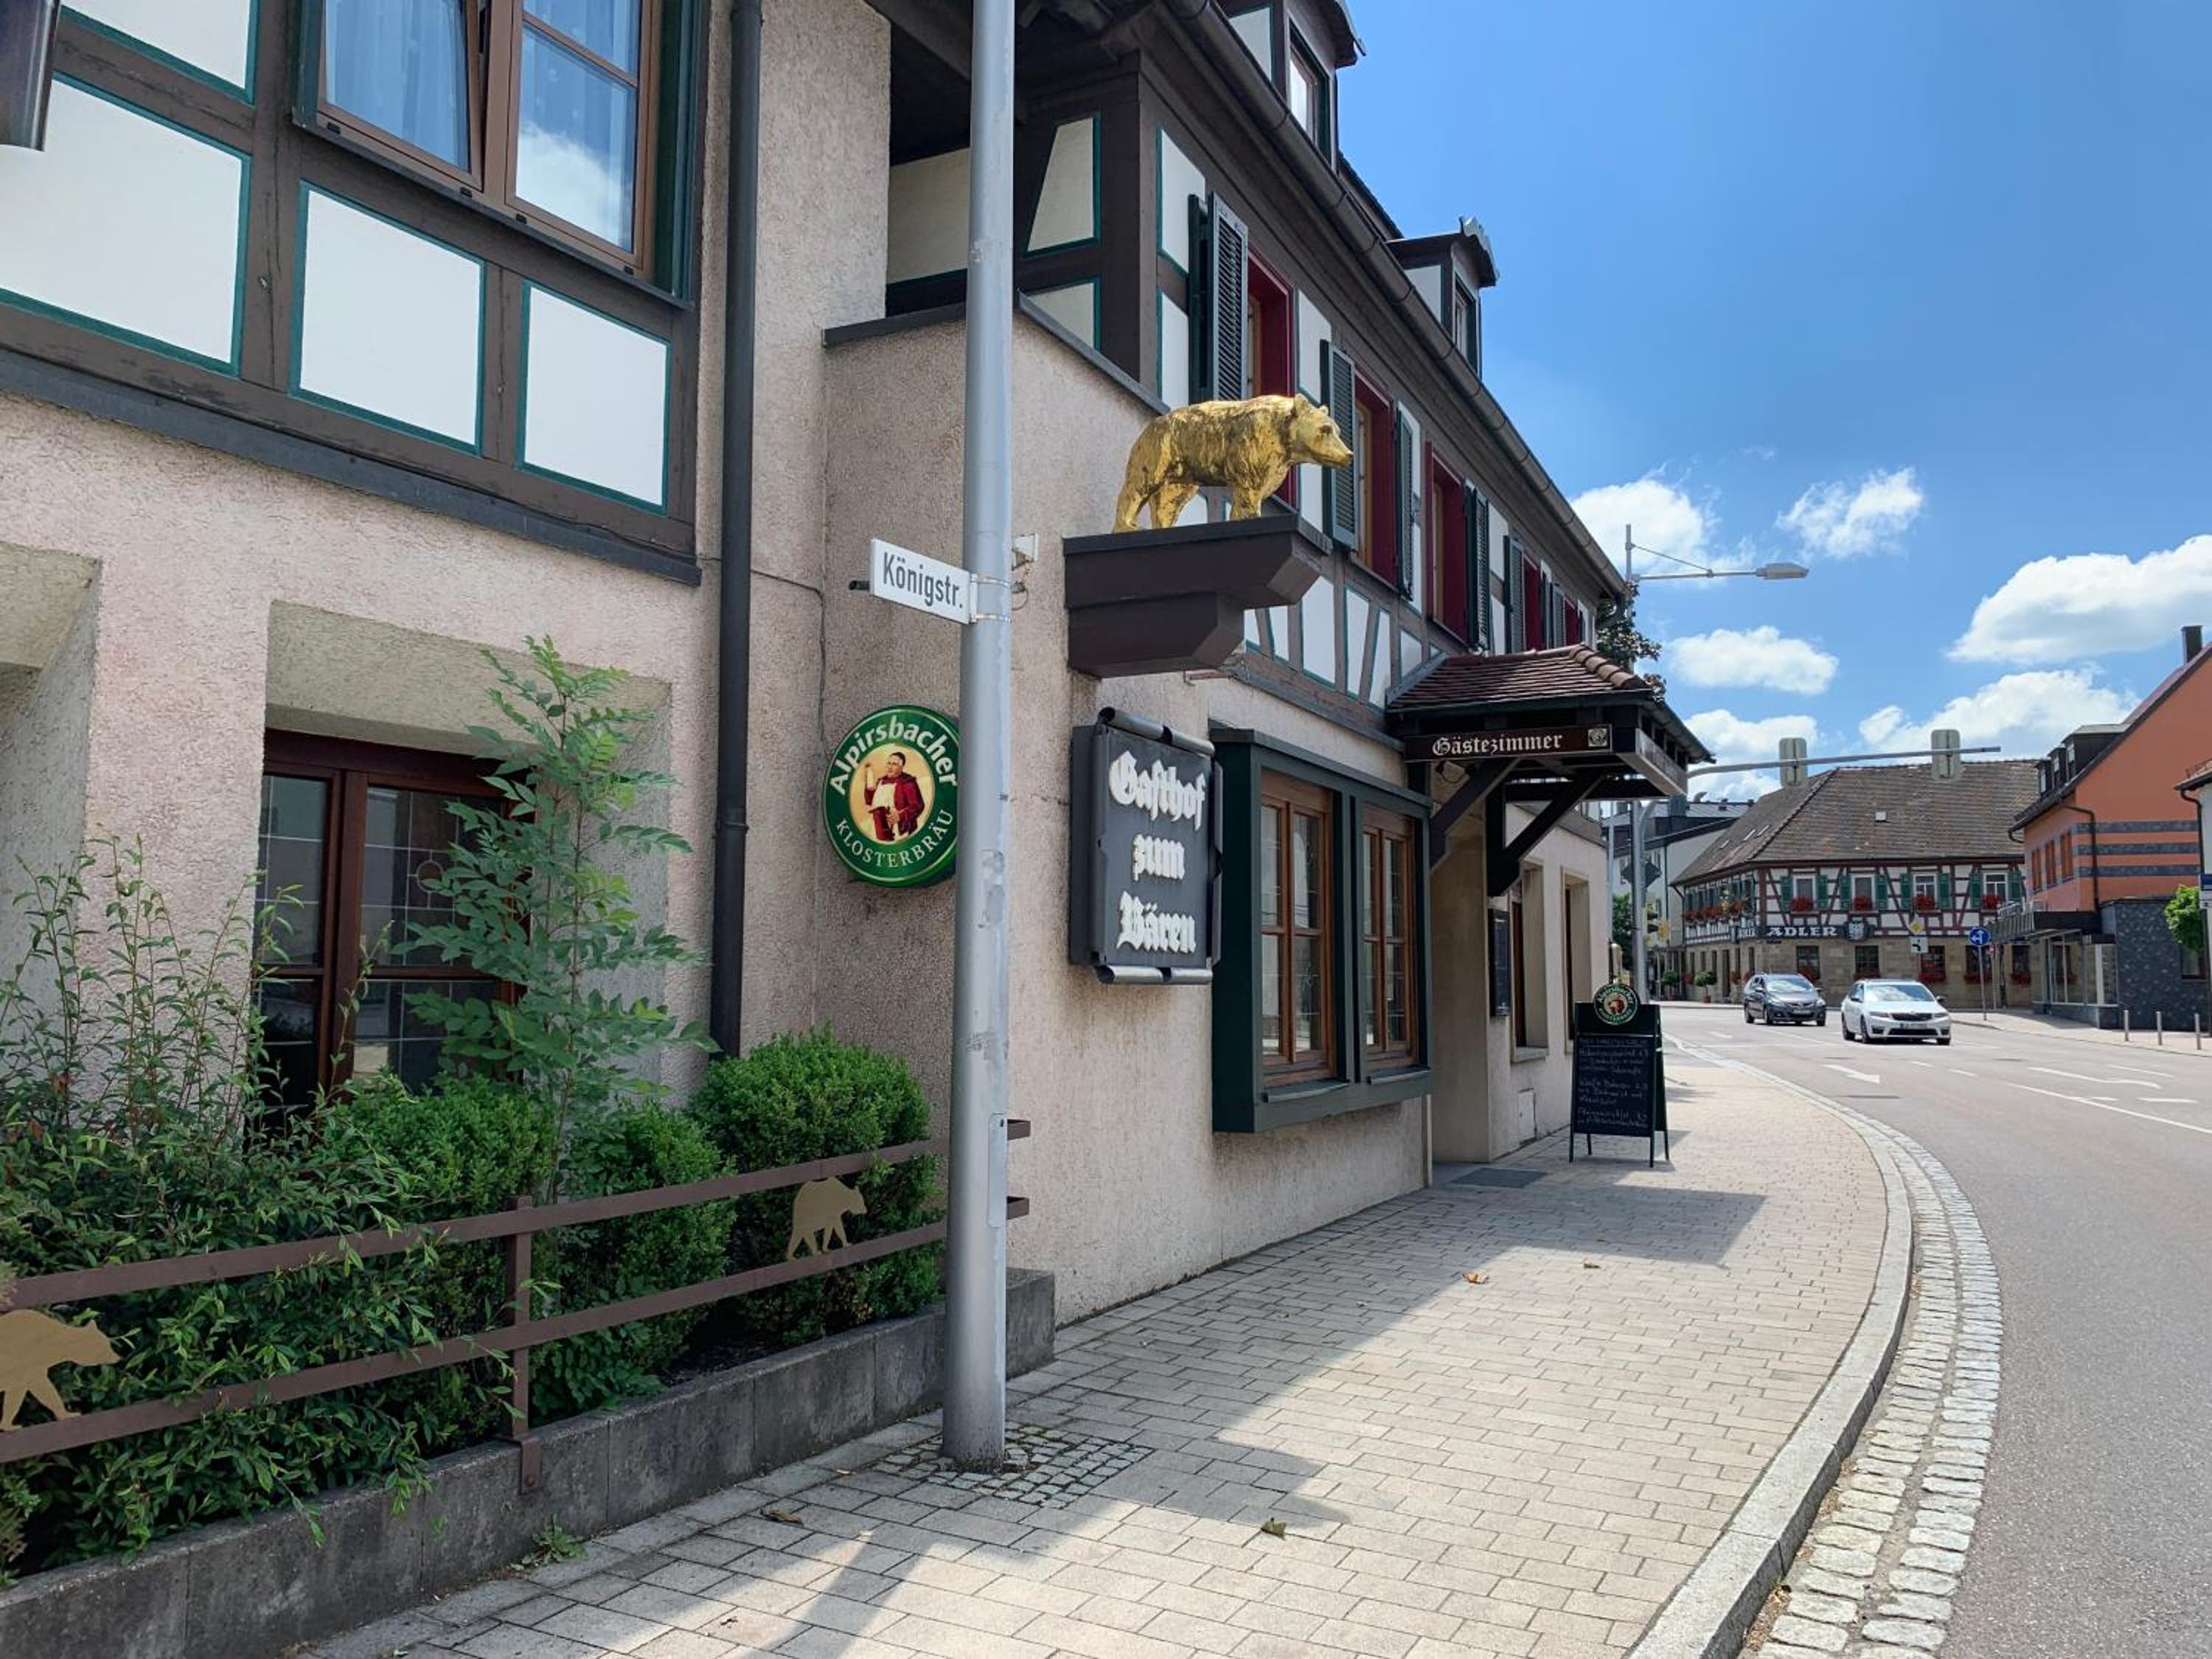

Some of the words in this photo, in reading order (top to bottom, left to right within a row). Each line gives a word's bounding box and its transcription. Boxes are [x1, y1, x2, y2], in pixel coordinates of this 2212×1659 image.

[883, 552, 962, 608] Königstr.
[830, 714, 957, 796] Alpirsbacher
[1433, 734, 1562, 756] Gästezimmer
[1109, 751, 1206, 831] Gasthof
[836, 810, 954, 868] KLOSTERBRÄU
[1133, 834, 1185, 881] zum
[1116, 891, 1196, 953] Bären
[1767, 926, 1838, 937] ADLER
